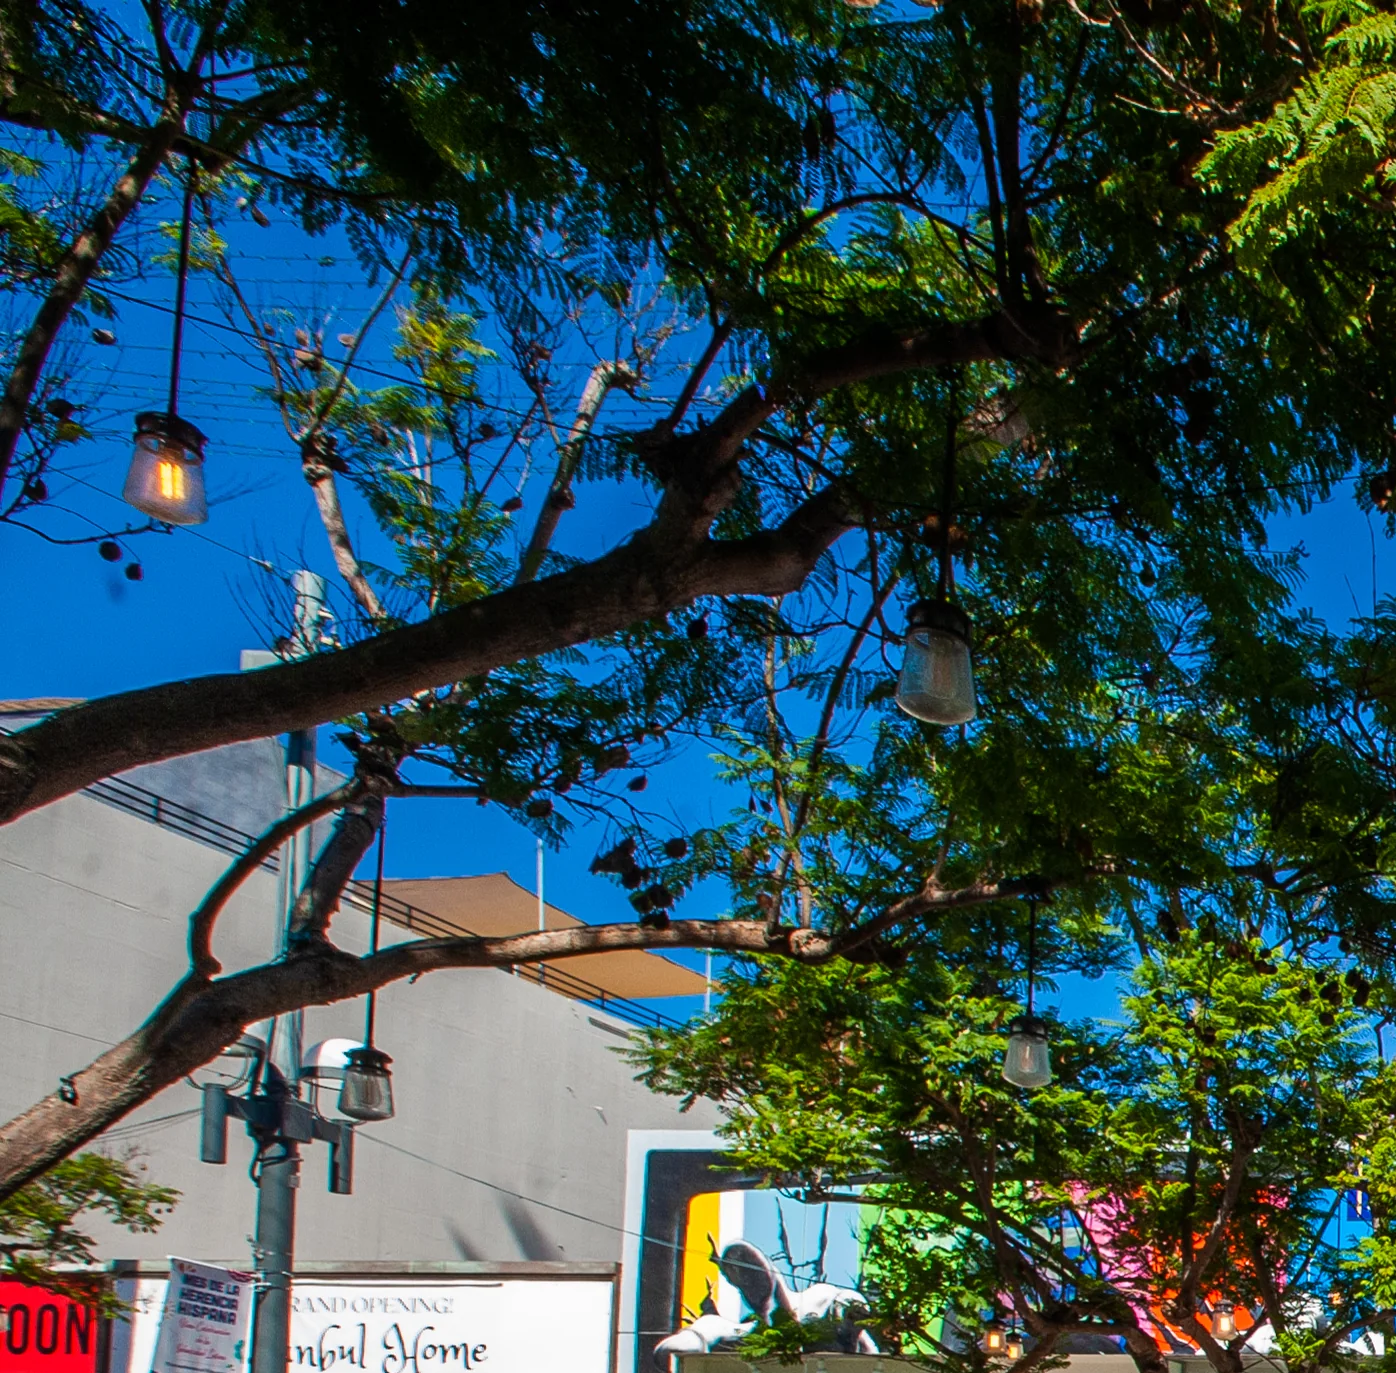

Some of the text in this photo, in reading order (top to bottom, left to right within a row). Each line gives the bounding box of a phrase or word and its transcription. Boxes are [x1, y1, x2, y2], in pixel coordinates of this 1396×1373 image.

[209, 1279, 225, 1292] DE
[225, 1283, 241, 1297] LA
[290, 1296, 455, 1314] RAND OPENING!
[287, 1323, 367, 1372] nbul
